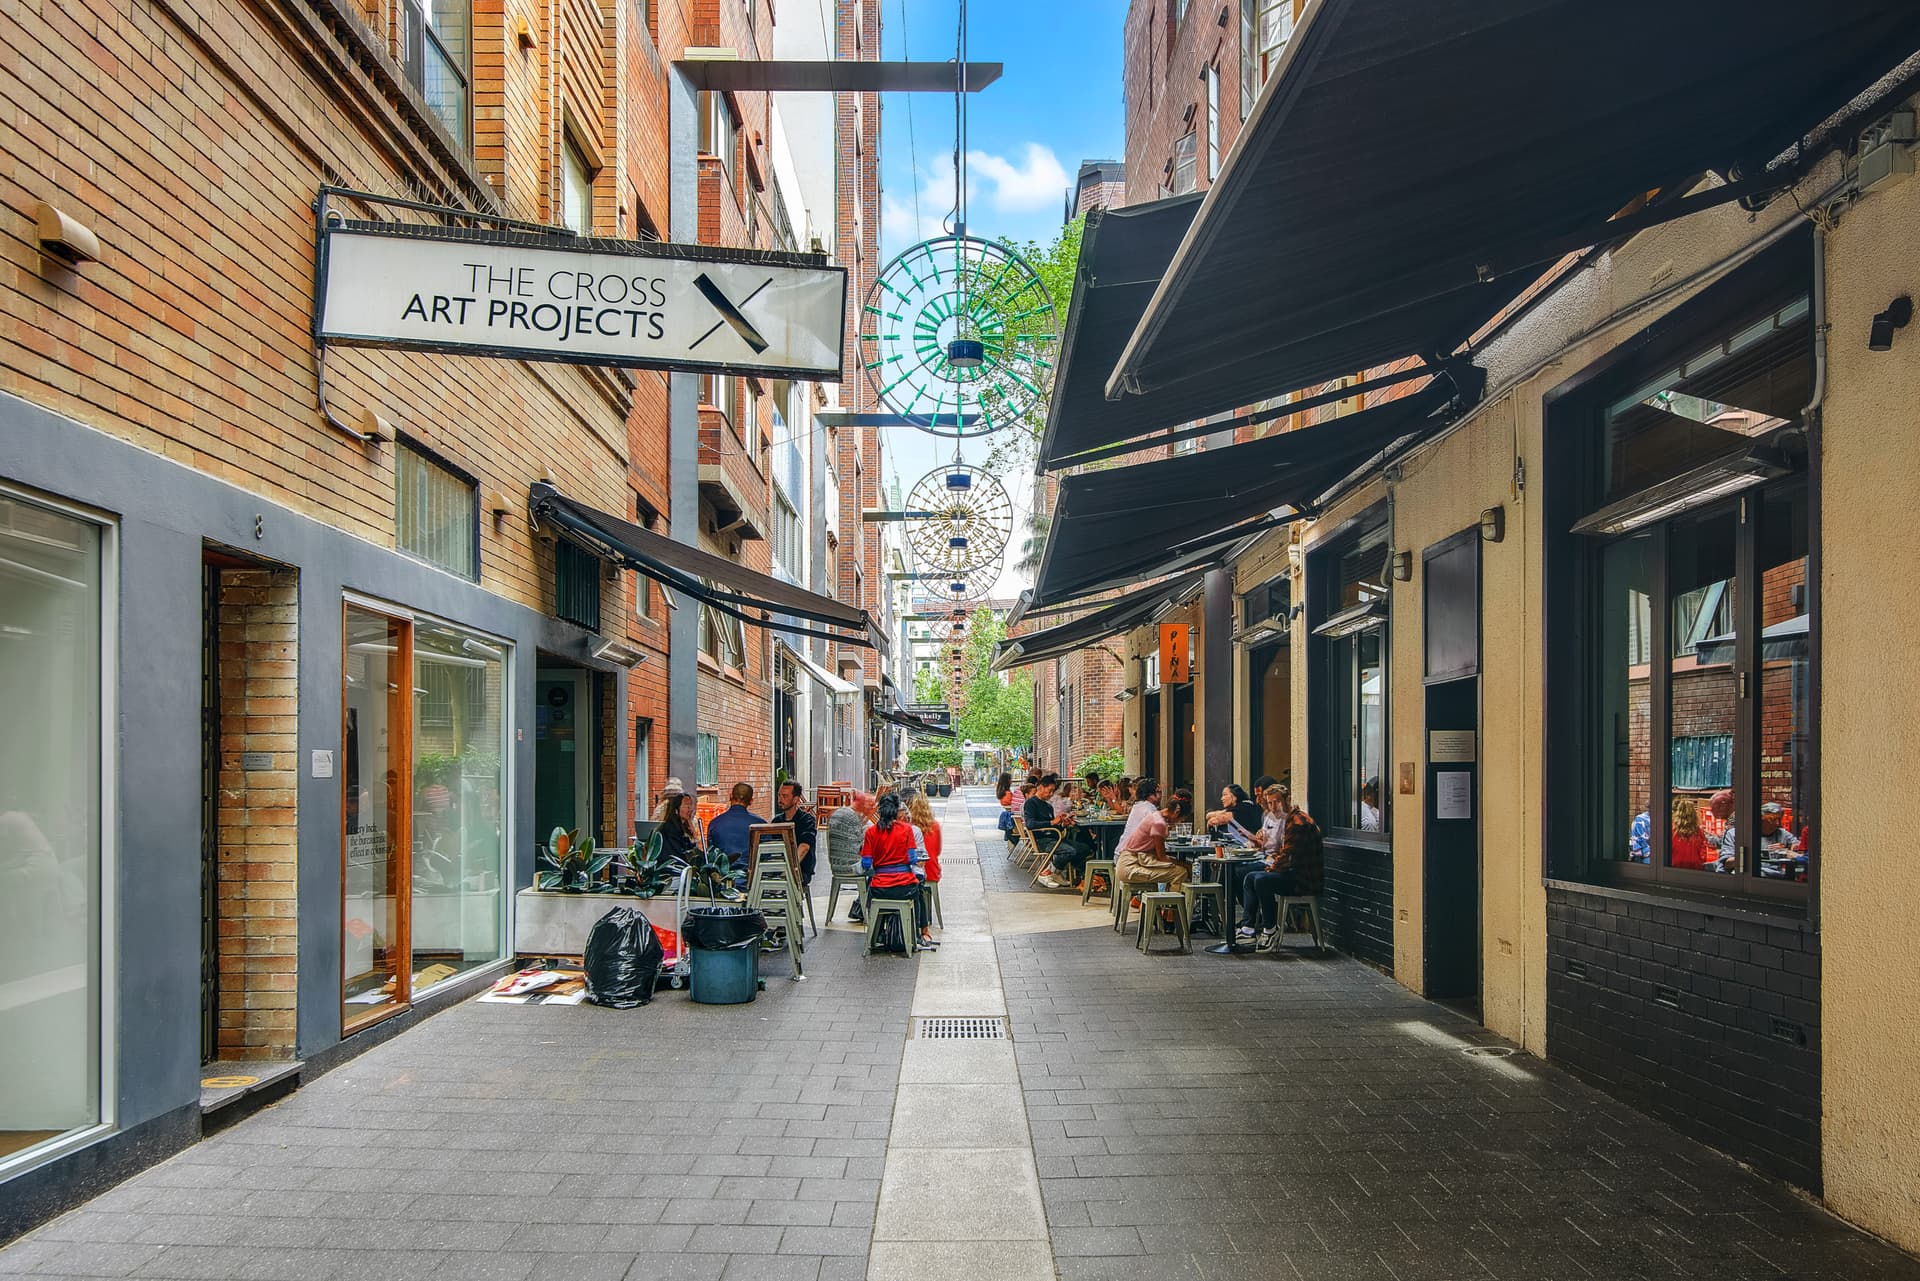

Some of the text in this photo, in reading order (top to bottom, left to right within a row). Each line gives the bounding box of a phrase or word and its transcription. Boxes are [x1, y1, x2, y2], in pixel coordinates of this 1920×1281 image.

[463, 263, 666, 307] THE CROSS
[401, 293, 665, 342] ART PROJECTS
[255, 513, 264, 539] 8
